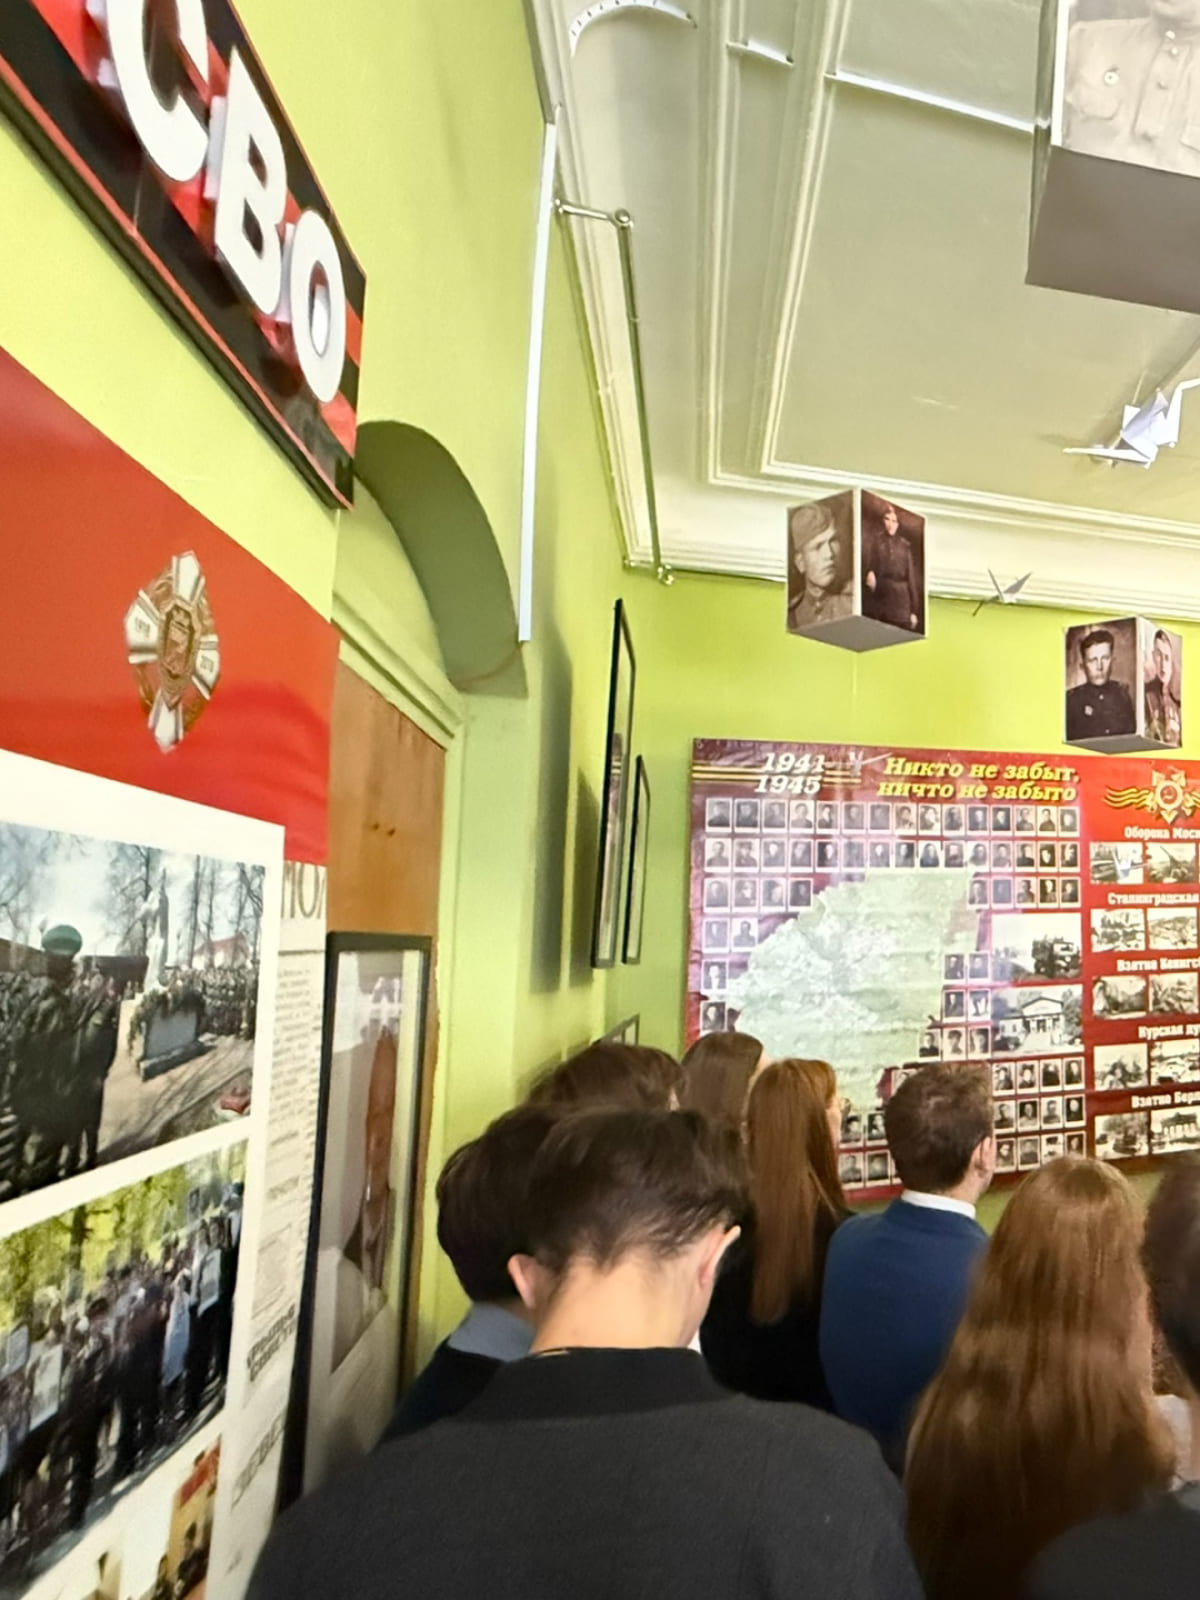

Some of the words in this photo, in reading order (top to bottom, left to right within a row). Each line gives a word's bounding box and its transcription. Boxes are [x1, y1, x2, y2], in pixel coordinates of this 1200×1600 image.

[106, 0, 346, 403] СВО
[765, 751, 826, 774] 1941
[883, 757, 963, 778] Никто
[968, 763, 998, 779] не
[1003, 761, 1080, 783] забыт,
[754, 774, 823, 794] 1945
[877, 780, 954, 799] ничто
[957, 783, 988, 799] не
[991, 781, 1077, 801] забыто
[1124, 826, 1170, 841] Оборона
[1107, 892, 1200, 906] Сталинградская
[1117, 959, 1158, 971] Взятие
[1138, 1025, 1184, 1040] Курская
[1131, 1095, 1172, 1108] Взятие
